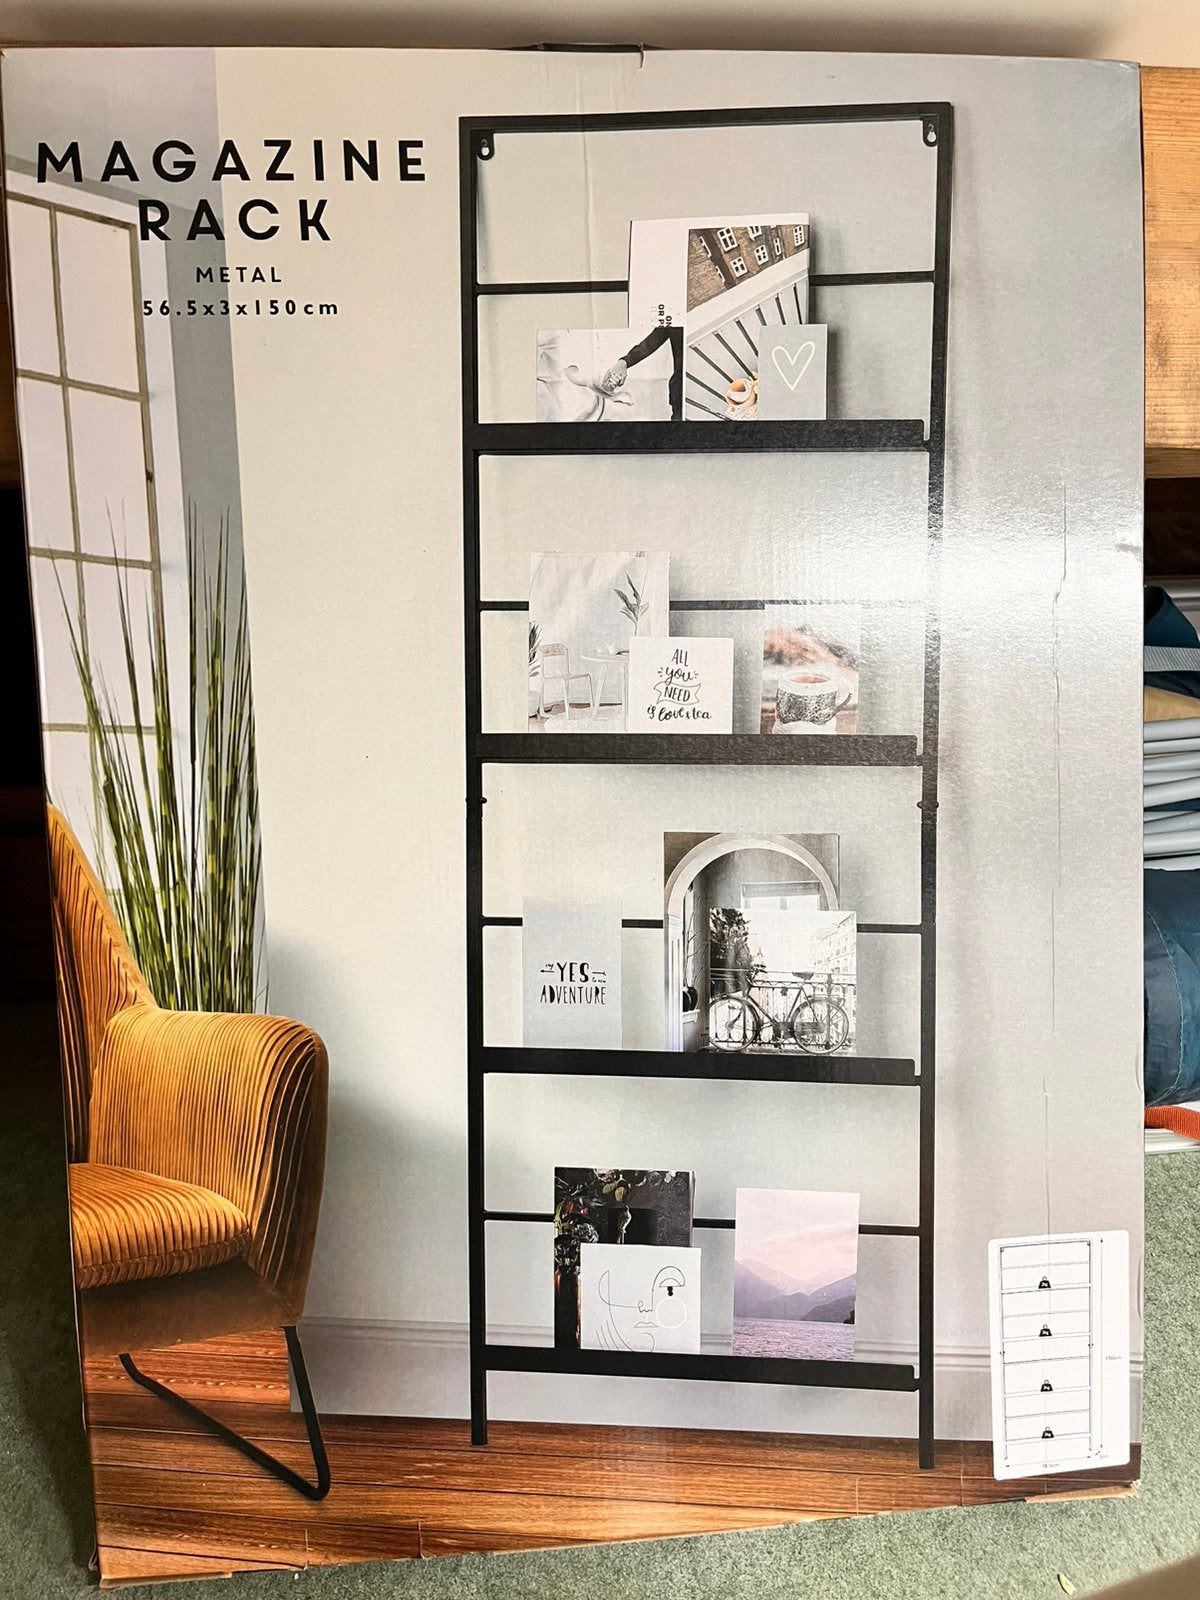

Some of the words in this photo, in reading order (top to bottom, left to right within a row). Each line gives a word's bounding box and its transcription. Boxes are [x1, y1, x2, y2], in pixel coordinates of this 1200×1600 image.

[36, 139, 426, 183] MAGAZINE
[138, 198, 331, 241] RACK
[196, 266, 283, 283] METAL
[671, 648, 688, 667] ALL
[665, 666, 693, 686] you
[664, 686, 691, 702] NEED
[556, 962, 589, 983] YES
[540, 984, 607, 1005] ADVENTURE
